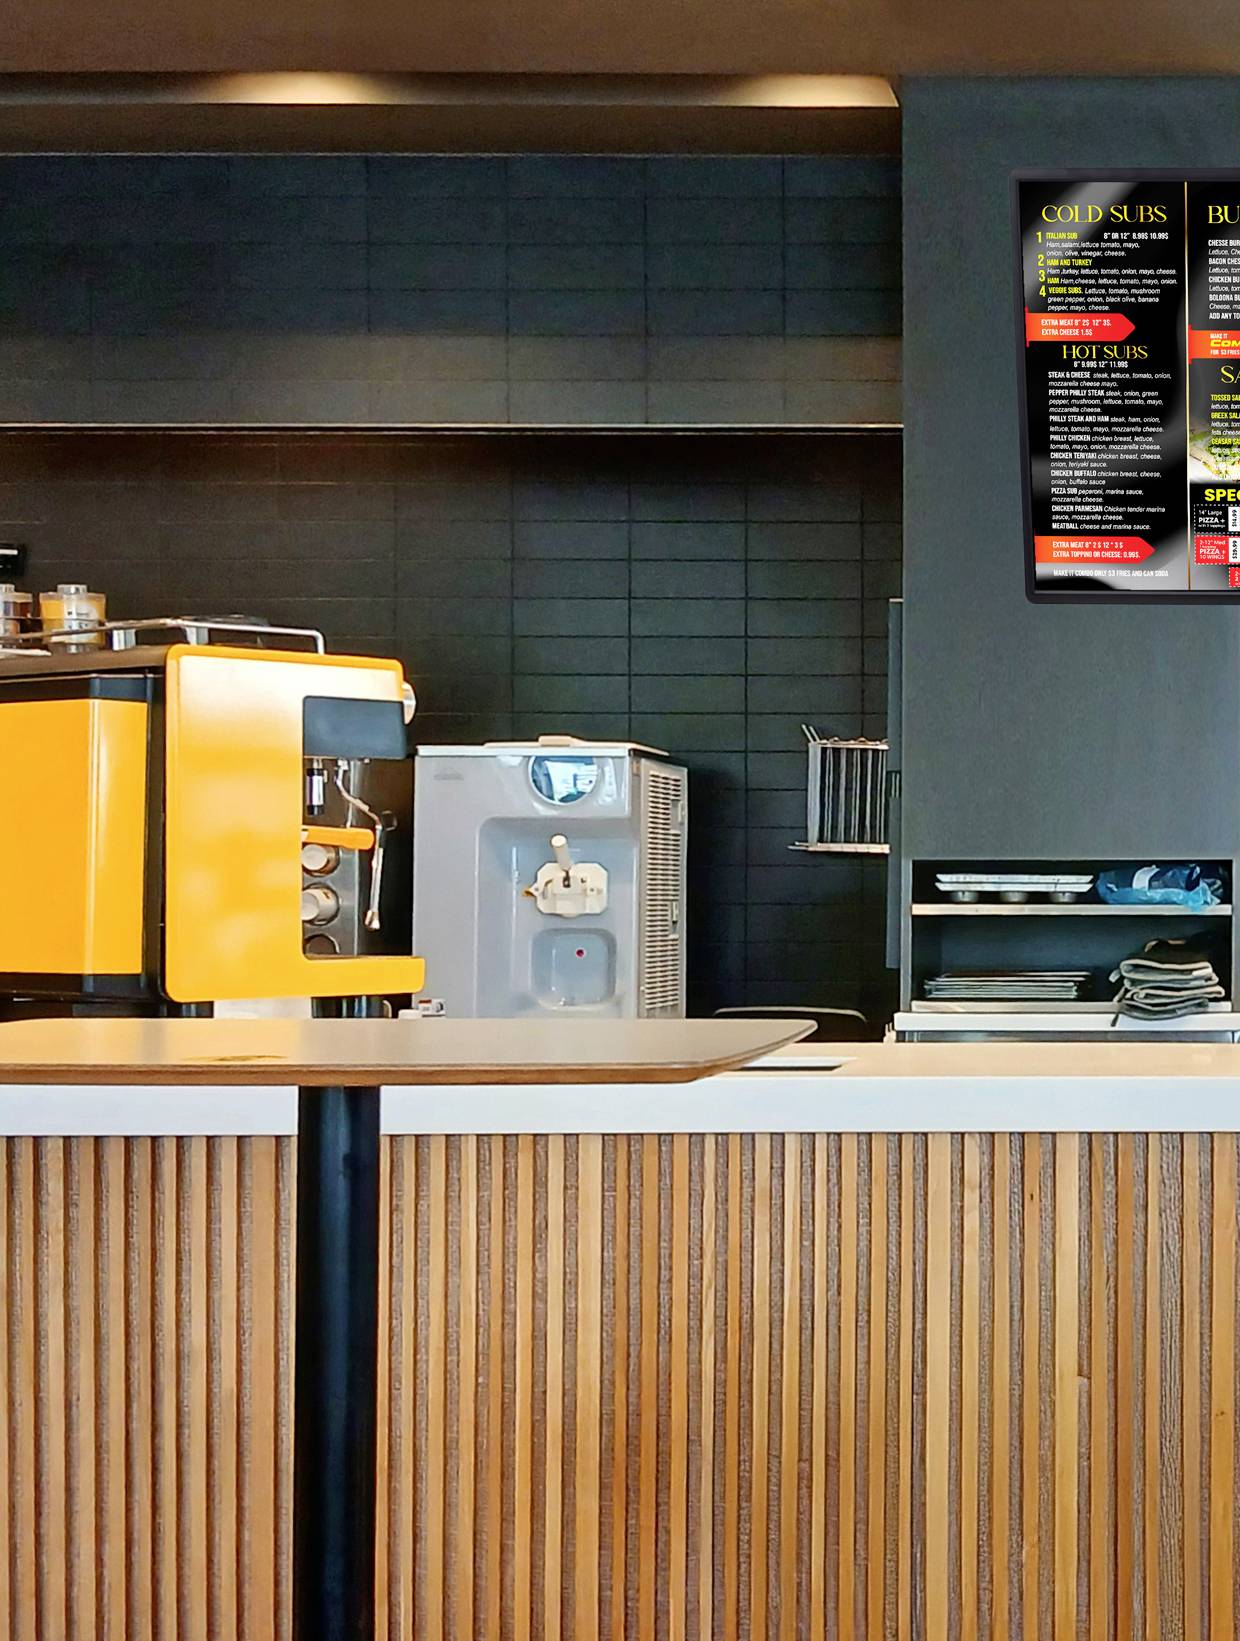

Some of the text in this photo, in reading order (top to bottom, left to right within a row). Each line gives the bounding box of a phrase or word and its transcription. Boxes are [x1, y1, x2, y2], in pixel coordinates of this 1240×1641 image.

[1042, 205, 1167, 222] COLD SUBS
[1037, 232, 1042, 243] 1
[1038, 255, 1044, 266] 2
[1039, 270, 1045, 282] 3
[1039, 285, 1046, 297] 4
[1063, 345, 1148, 359] HOT SUBS
